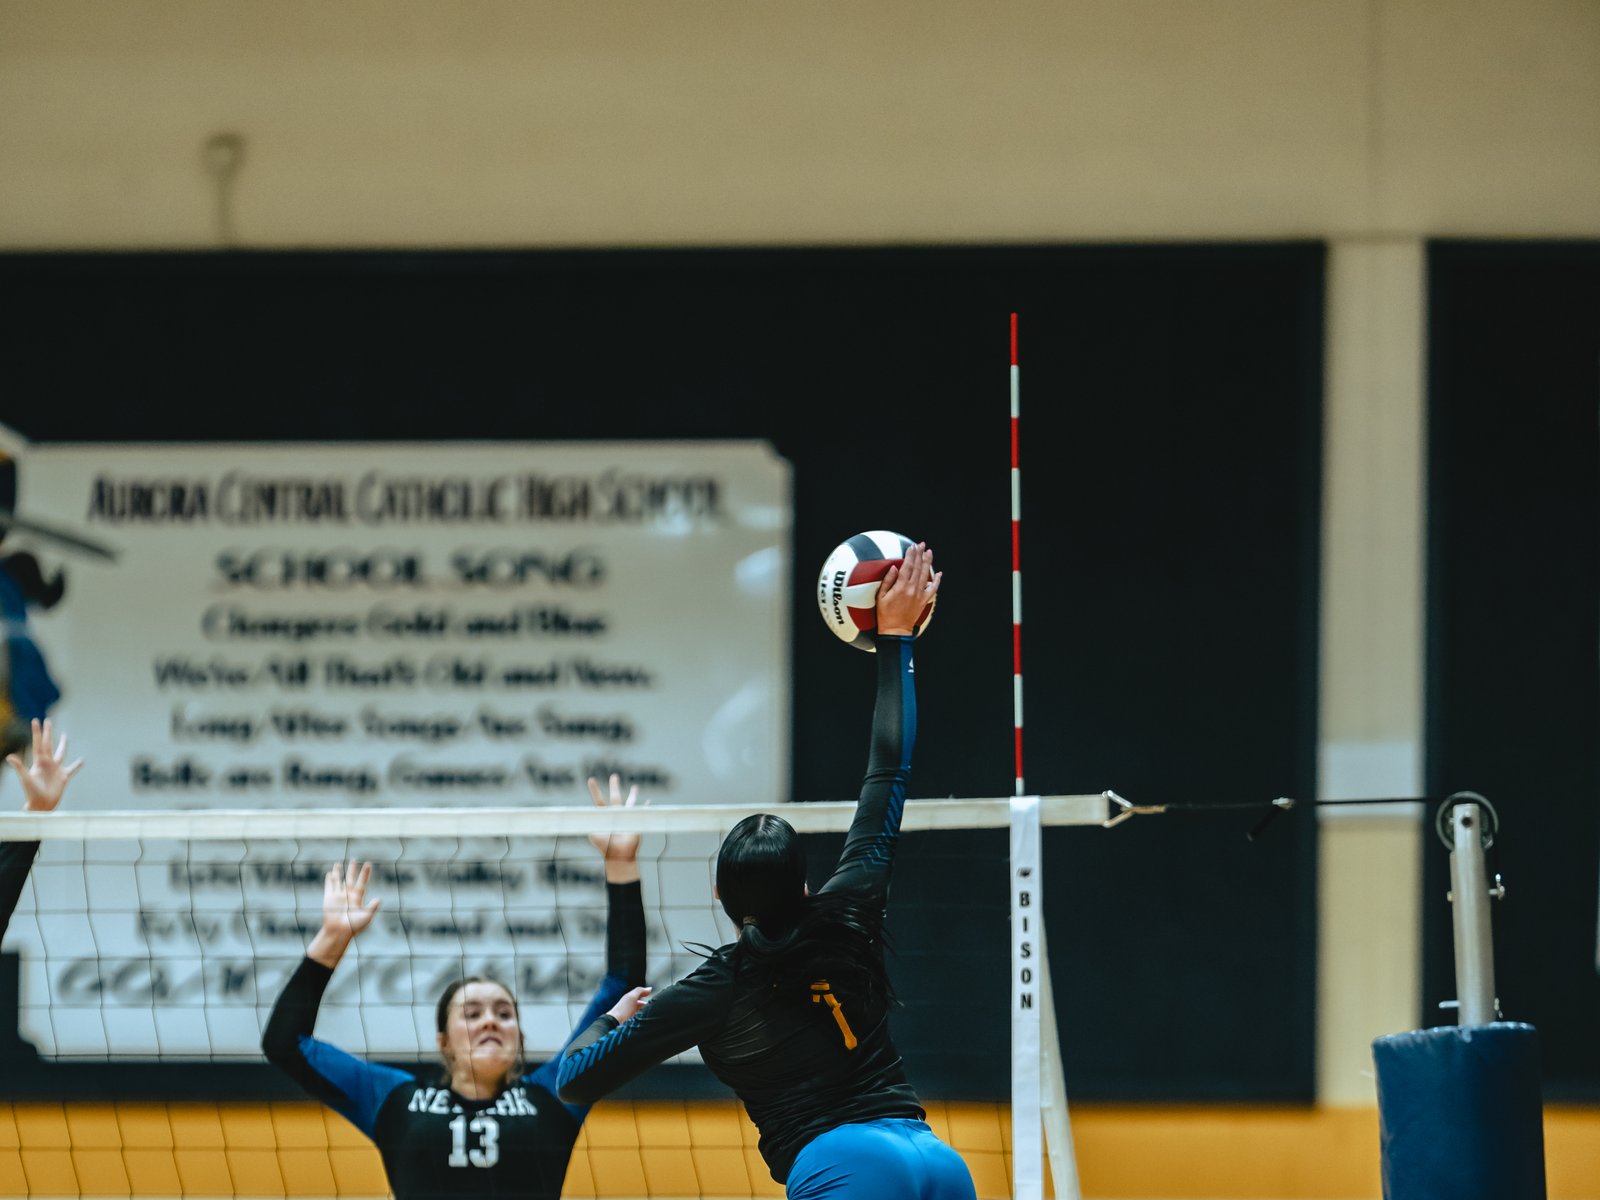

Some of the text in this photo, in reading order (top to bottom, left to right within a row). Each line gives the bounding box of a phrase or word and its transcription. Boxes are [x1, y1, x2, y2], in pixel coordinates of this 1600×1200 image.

[214, 550, 606, 590] SCHOOL SONG
[832, 570, 847, 625] Wilson
[1018, 891, 1032, 1010] BISON
[448, 1115, 500, 1168] 13
